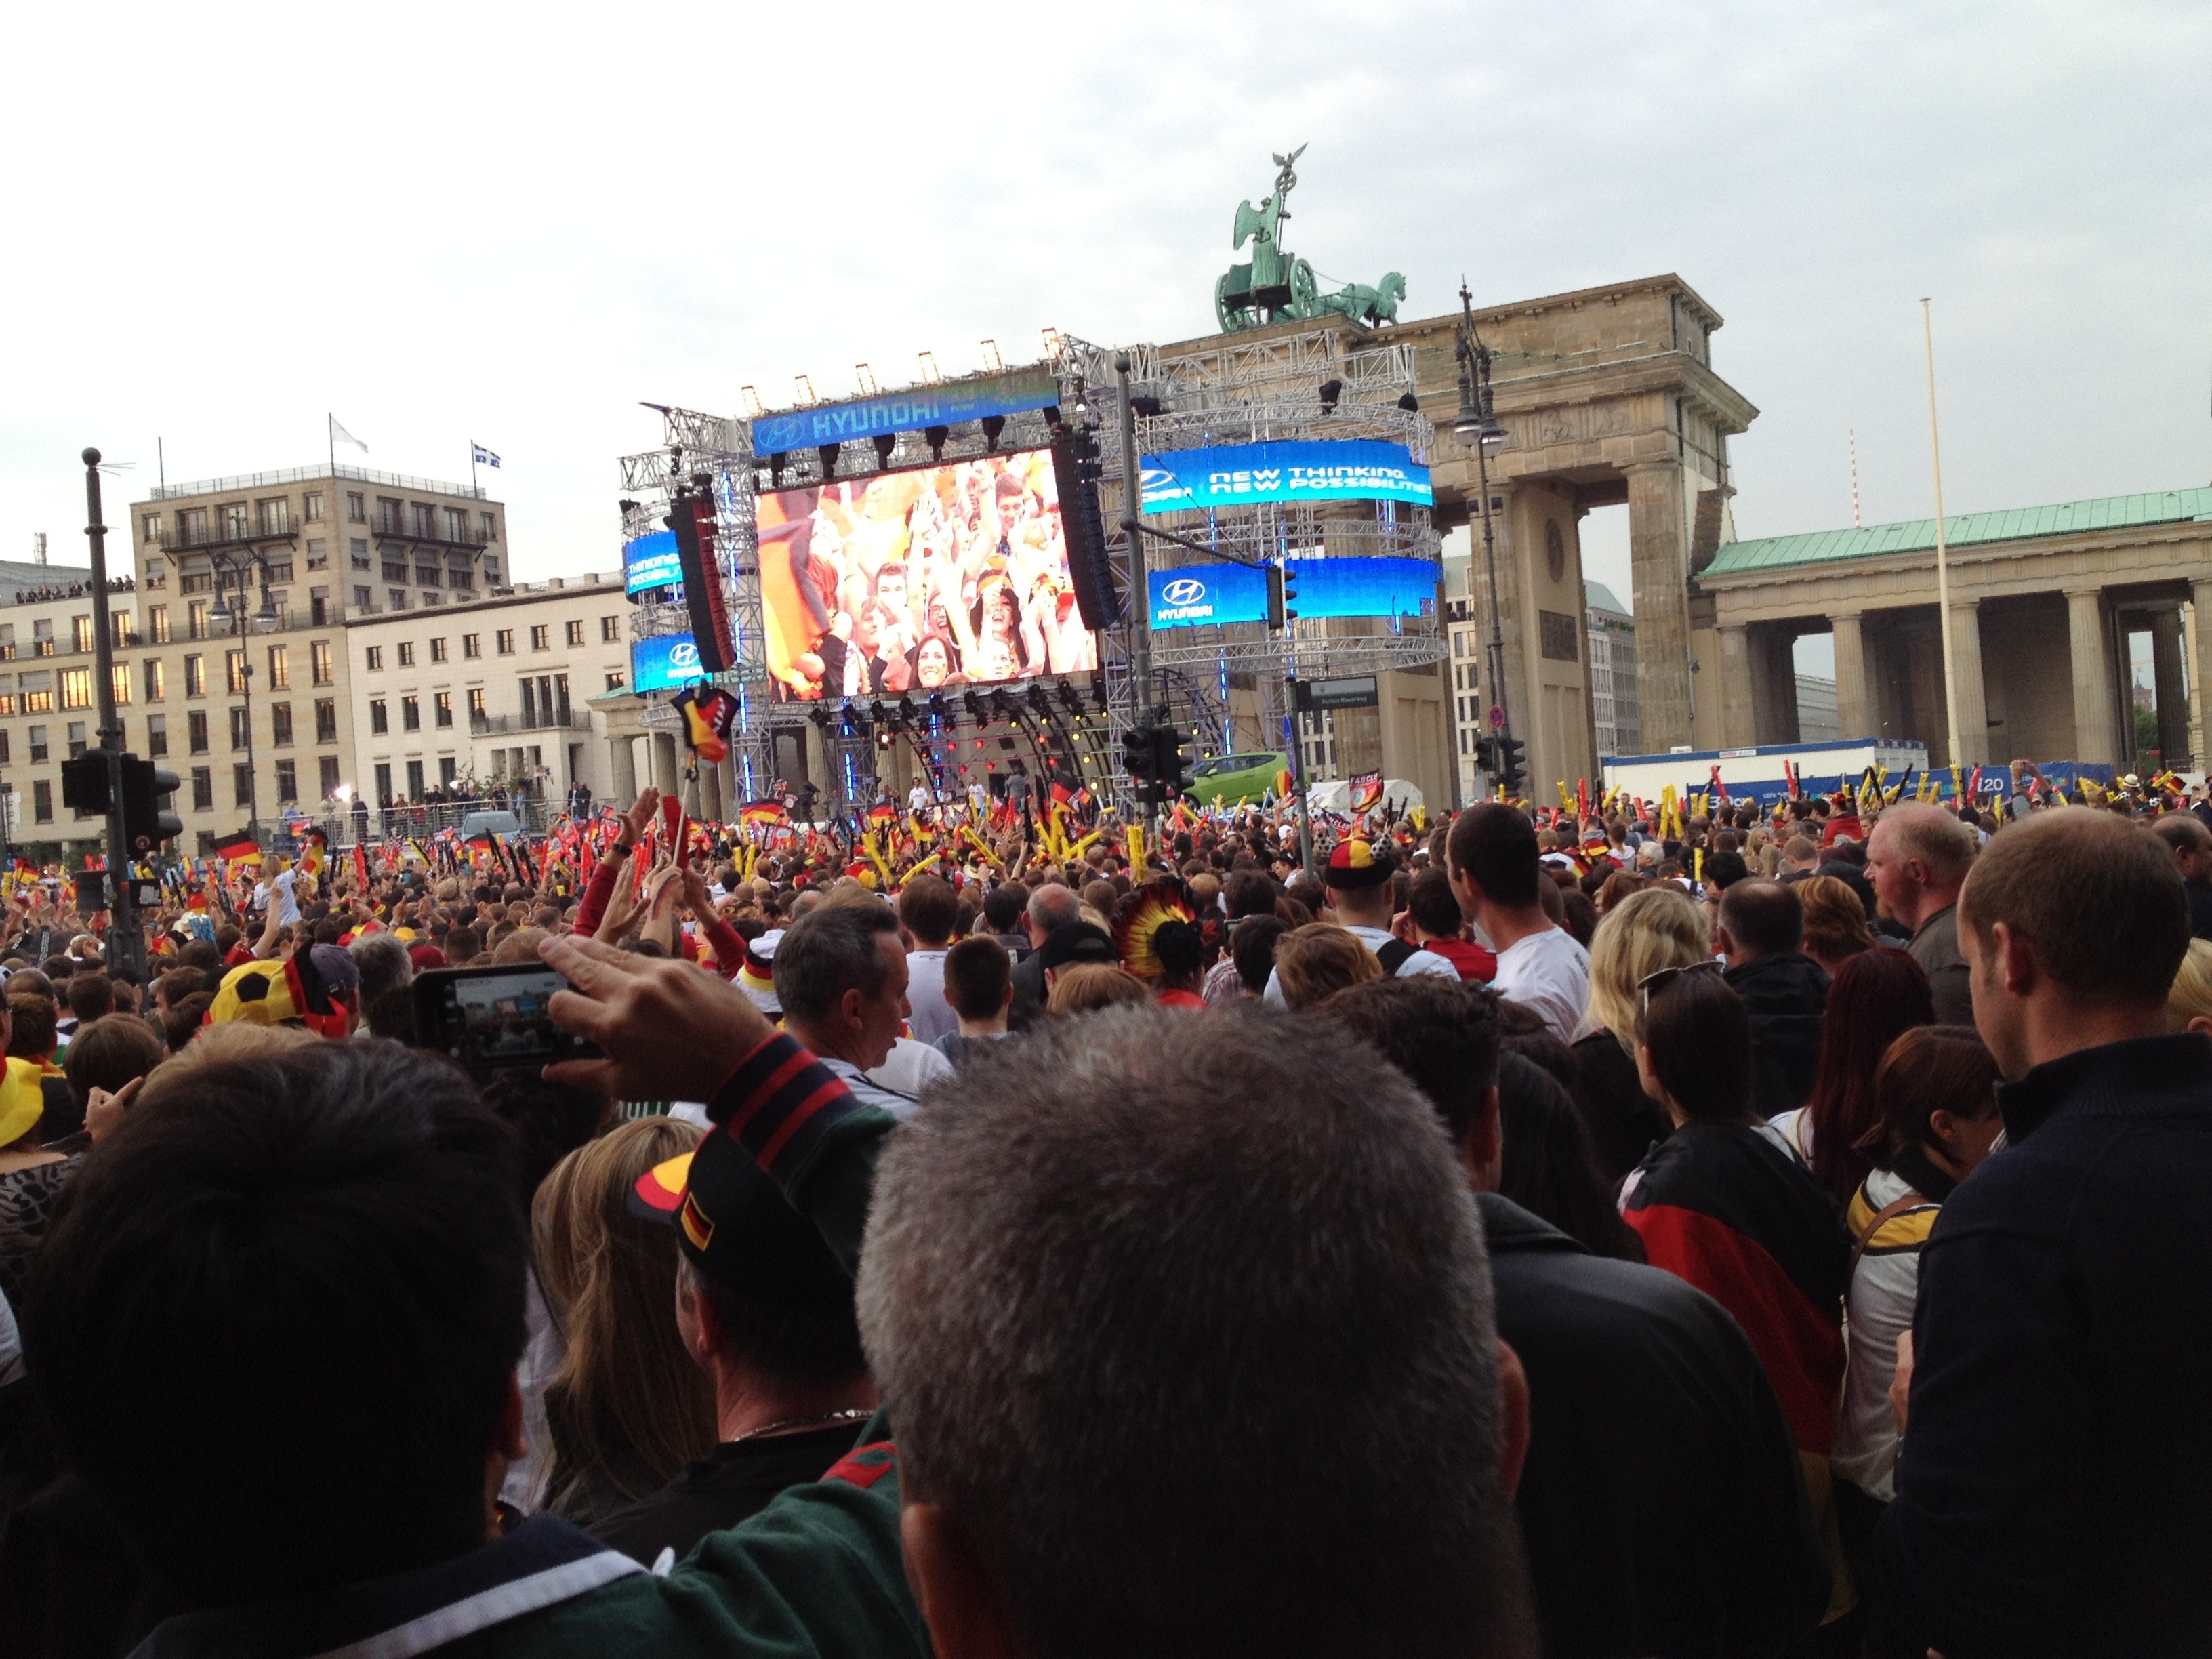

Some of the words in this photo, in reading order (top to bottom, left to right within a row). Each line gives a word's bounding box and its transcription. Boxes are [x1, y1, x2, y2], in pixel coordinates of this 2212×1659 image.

[814, 399, 939, 439] HYUNDAI
[1209, 469, 1280, 483] NEW
[1210, 480, 1281, 494] NEW
[1157, 605, 1213, 621] HYUNDAI
[1977, 777, 2004, 792] i20
